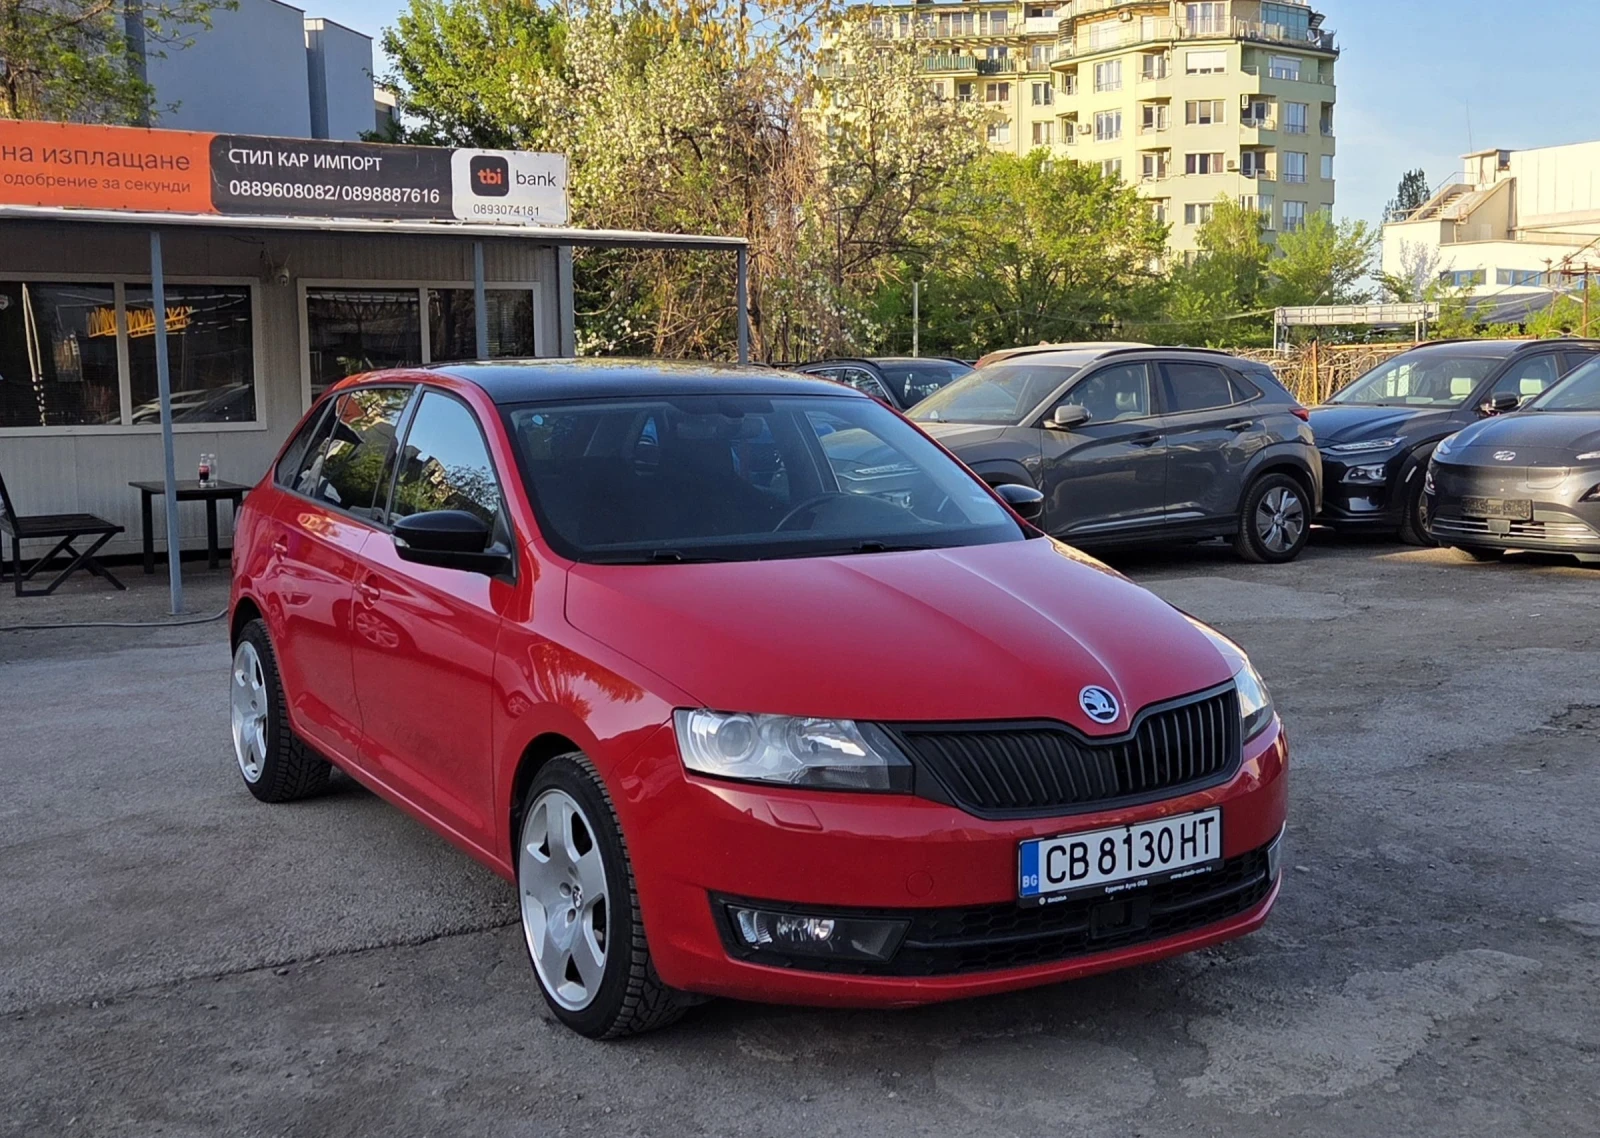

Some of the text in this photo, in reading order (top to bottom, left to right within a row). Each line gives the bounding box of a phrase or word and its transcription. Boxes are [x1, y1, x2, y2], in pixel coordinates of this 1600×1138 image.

[2, 145, 190, 171] на изплащане
[228, 148, 382, 172] СТИЛ КАР ИМПОРТ
[3, 172, 190, 193] одобрение за секунди
[477, 169, 556, 187] tbi bank
[473, 203, 540, 216] 0893074181
[1046, 816, 1215, 884] CB 8130 HT
[1022, 875, 1038, 888] BG
